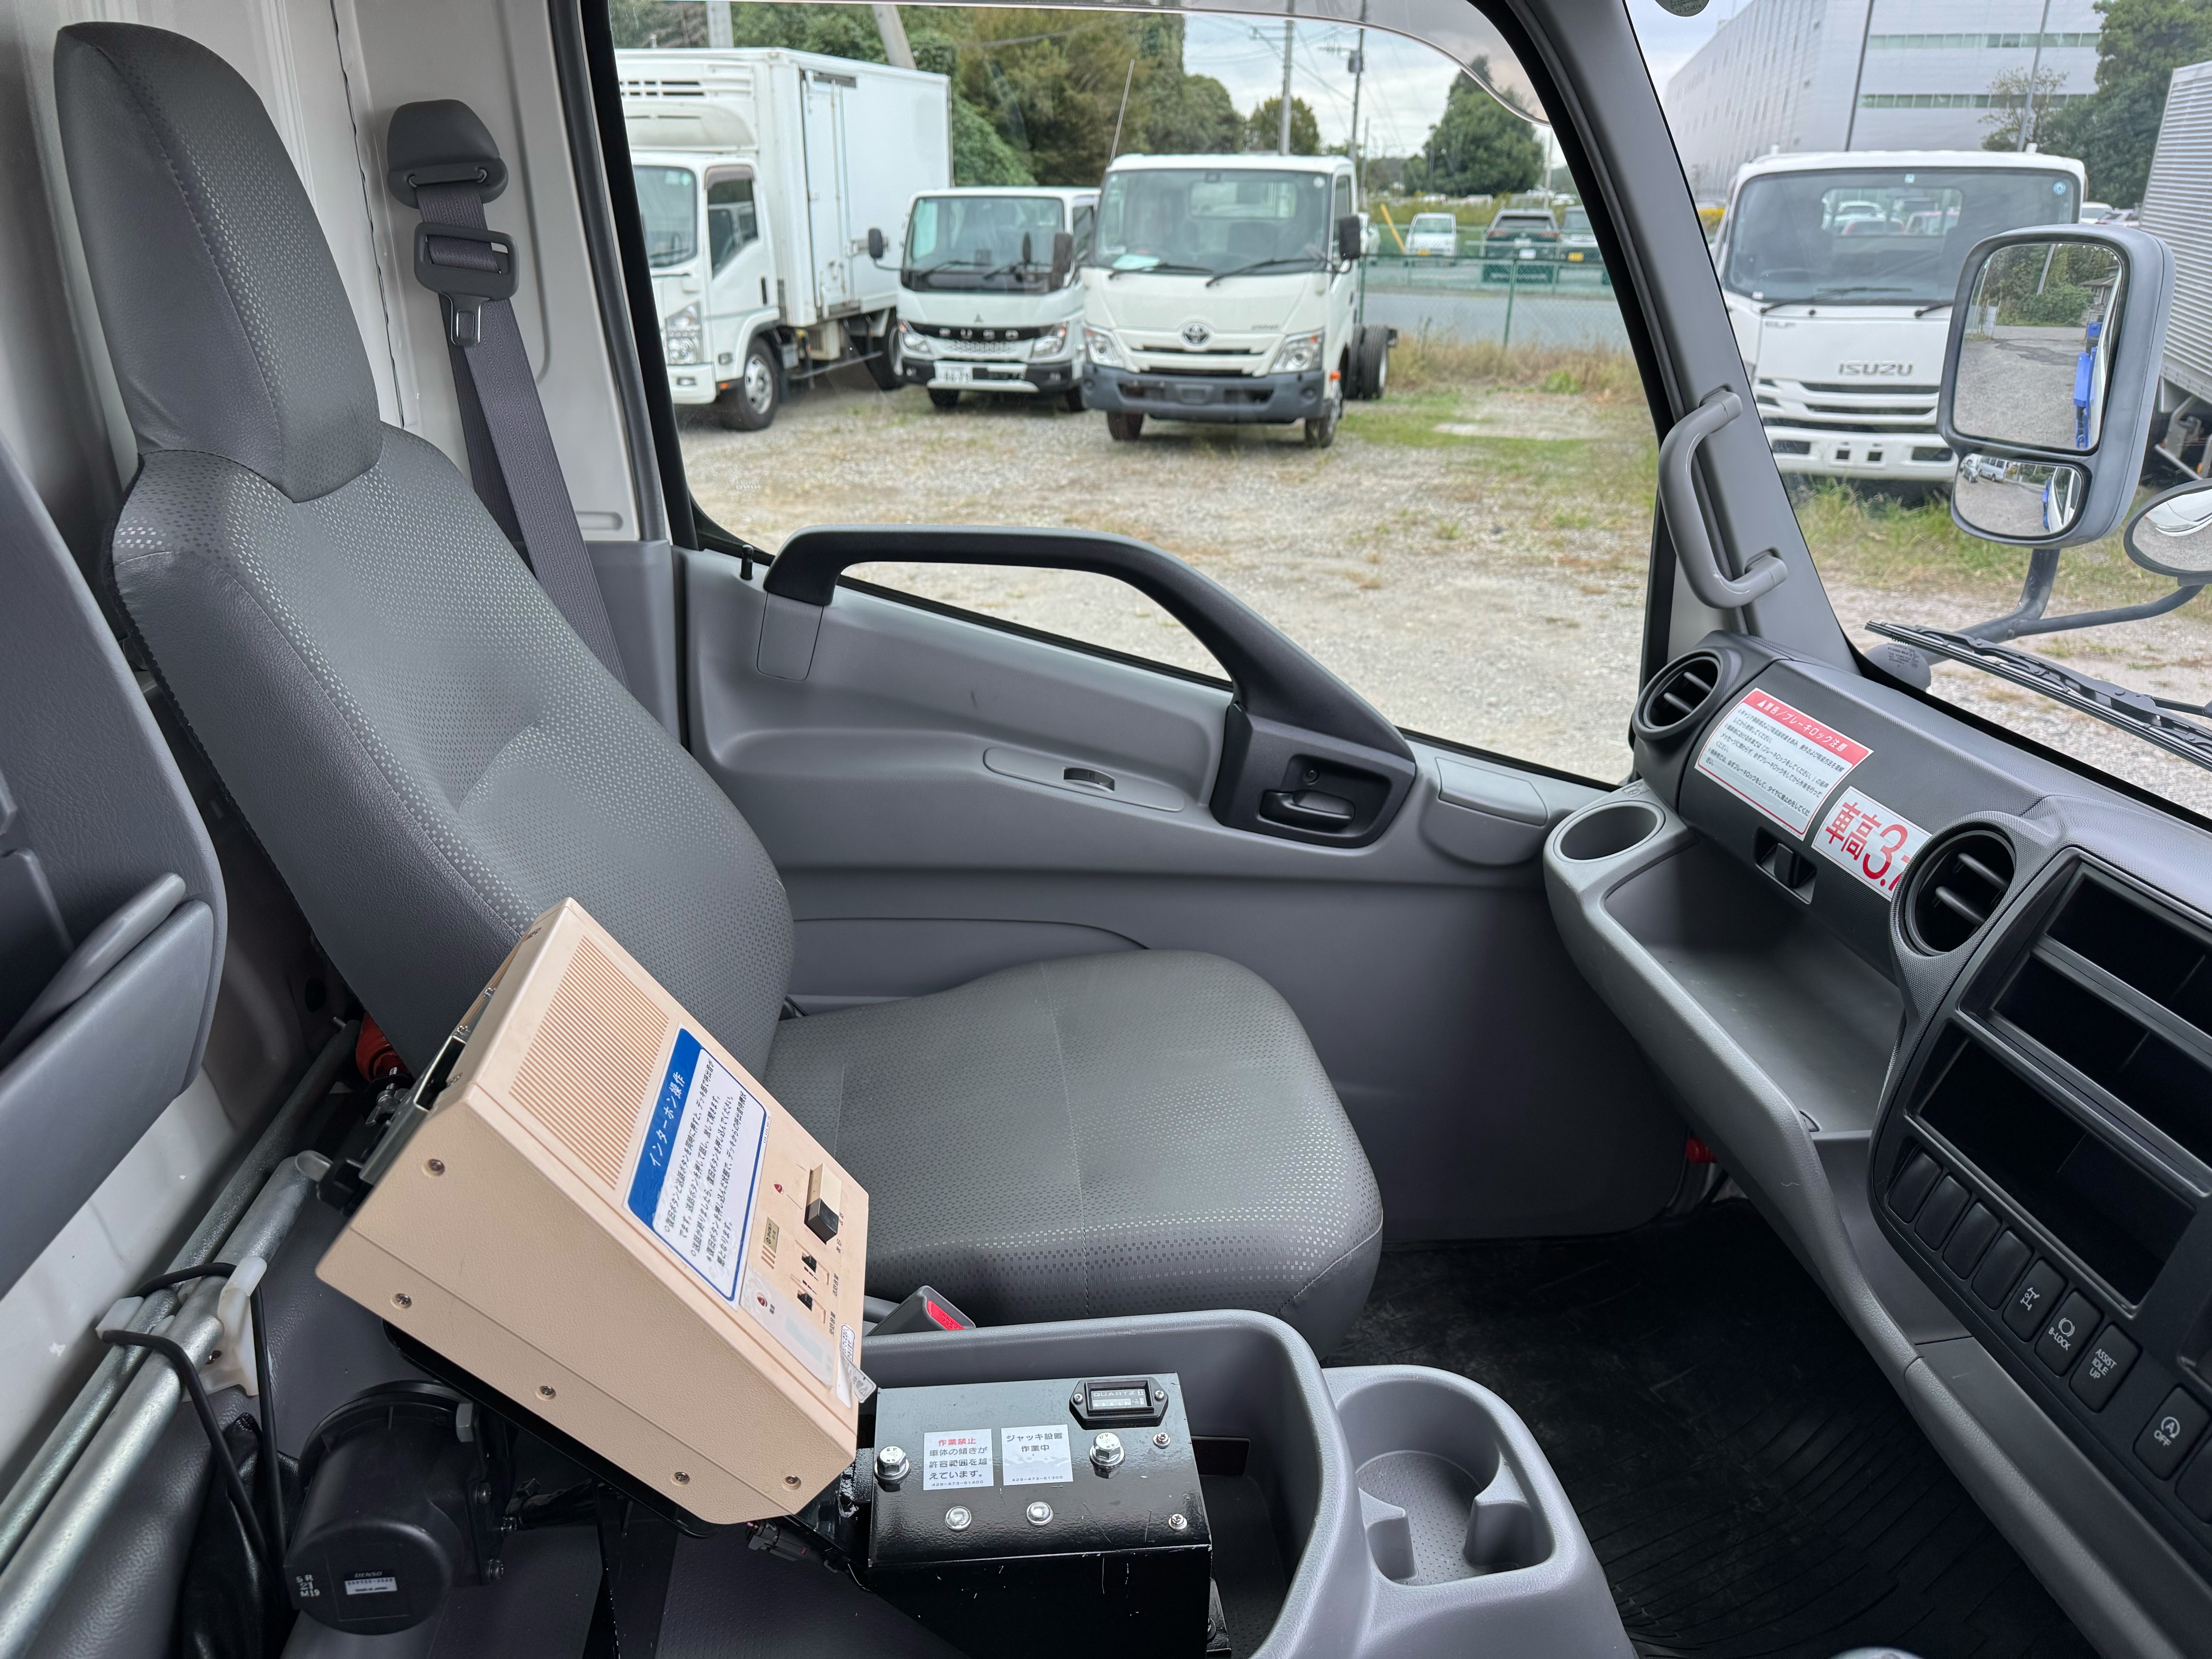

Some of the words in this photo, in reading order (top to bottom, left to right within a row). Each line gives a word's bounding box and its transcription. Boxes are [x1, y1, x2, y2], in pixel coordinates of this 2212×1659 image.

[1838, 360, 1913, 376] ISUZU
[647, 1068, 686, 1172] インターホン操作
[2048, 1327, 2071, 1351] B-LOCK
[2095, 1348, 2117, 1369] ASSIST
[2089, 1367, 2101, 1379] UP
[2092, 1358, 2109, 1376] IDLE
[938, 1437, 976, 1446] 作業禁止
[1005, 1432, 1063, 1442] ジャッキ設置
[2153, 1429, 2172, 1446] OFF
[929, 1446, 988, 1456] 車体の傾きが
[1020, 1444, 1049, 1453] 作業中
[929, 1458, 988, 1468] 許容範囲を越
[929, 1469, 982, 1480] えています。
